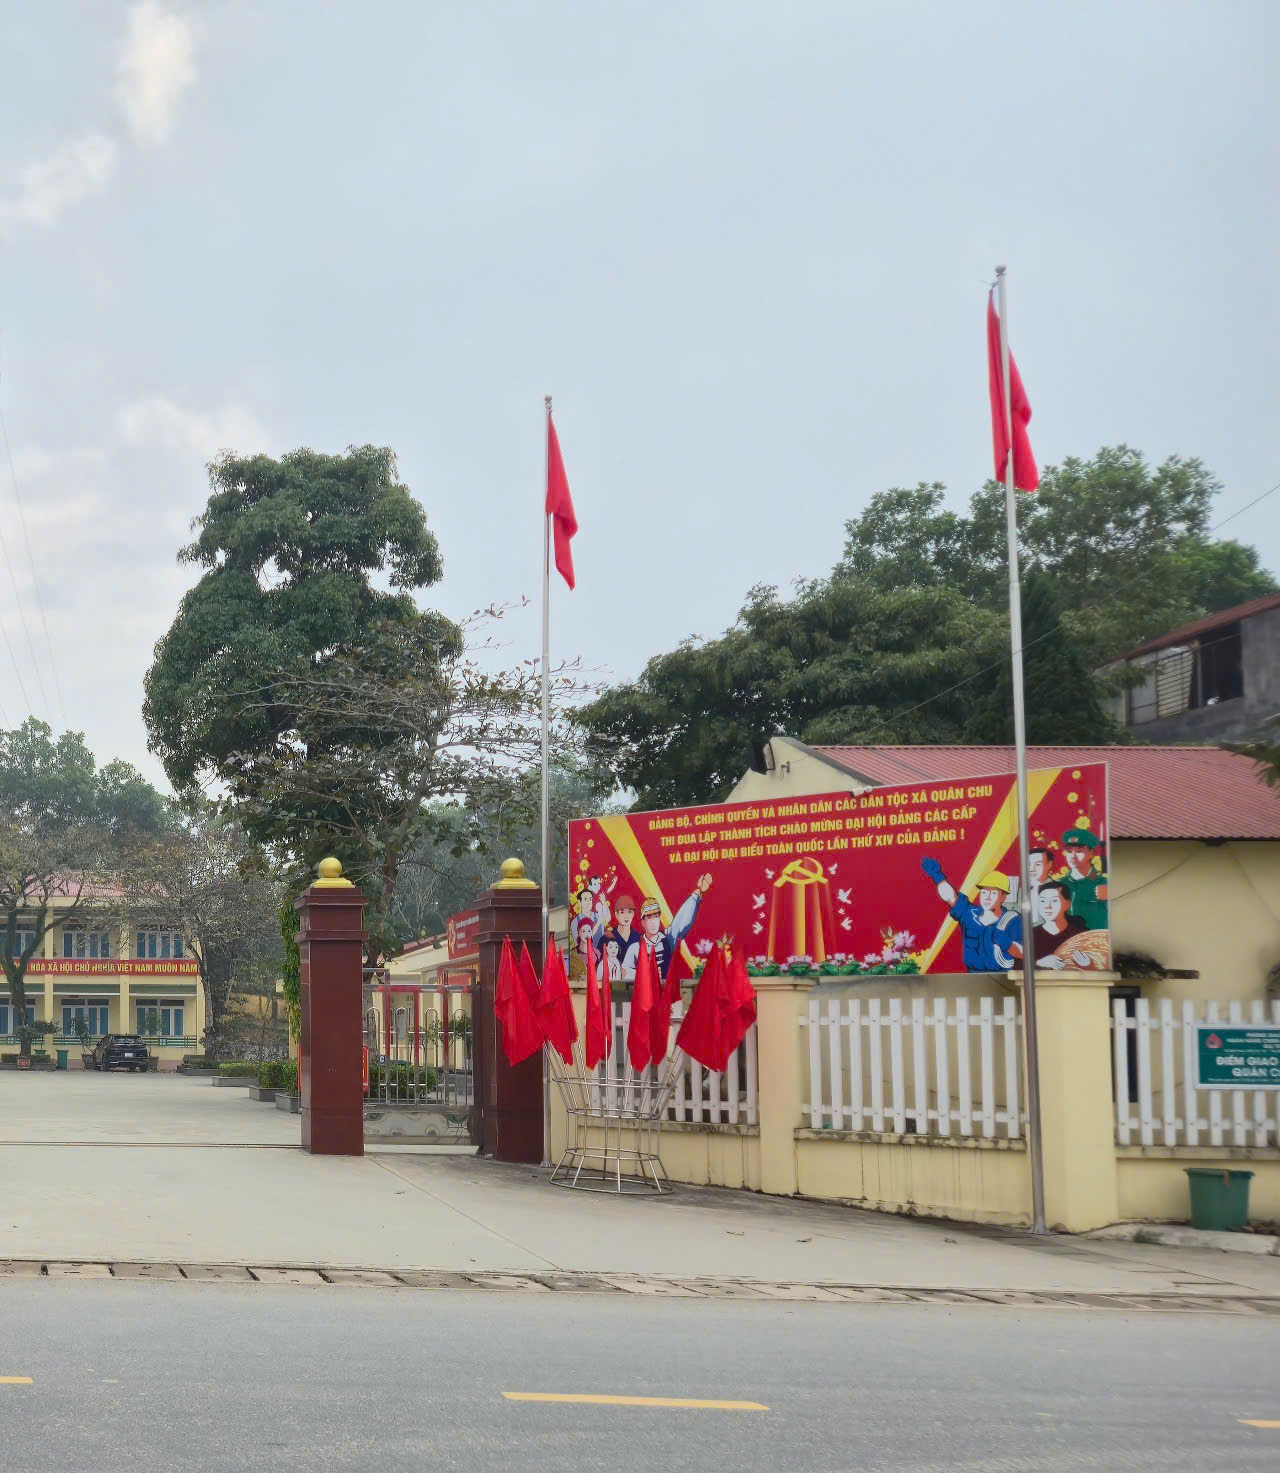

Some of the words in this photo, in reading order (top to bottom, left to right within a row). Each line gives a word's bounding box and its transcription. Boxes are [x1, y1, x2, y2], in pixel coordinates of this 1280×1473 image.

[649, 816, 674, 830] ĐẢNG
[695, 813, 724, 826] CHÍNH
[727, 807, 759, 823] QUYỀN
[762, 807, 775, 818] VÀ
[778, 803, 807, 817] NHÂN
[811, 800, 833, 814] DÂN
[835, 797, 857, 811] CÁC
[861, 795, 883, 809] DÂN
[886, 792, 908, 807] TỘC
[912, 790, 928, 804] XÃ
[931, 787, 964, 803] QUÂN
[967, 785, 993, 798] CHU
[660, 835, 675, 846] THI
[677, 833, 696, 845] ĐUA
[698, 830, 717, 845] LẬP
[719, 827, 752, 841] THÀNH
[755, 823, 776, 838] TÍCH
[780, 821, 808, 835] CHÀO
[811, 818, 843, 833] MỪNG
[846, 817, 864, 831] ĐẠI
[867, 814, 886, 829] HỘI
[889, 810, 922, 826] ĐẢNG
[924, 807, 948, 822] CÁC
[952, 803, 976, 820] CẤP
[669, 851, 681, 864] VÀ
[684, 851, 700, 864] ĐẠI
[702, 848, 719, 862] HỘI
[721, 847, 738, 861] ĐẠI
[740, 842, 764, 857] BIỂU
[766, 840, 793, 855] TOÀN
[796, 837, 824, 854] QUỐC
[827, 835, 848, 850] LẦN
[850, 833, 873, 848] THỨ
[875, 834, 893, 846] XIV
[897, 828, 920, 845] CỦA
[923, 826, 956, 843] ĐẢNG
[48, 961, 58, 972] XÃ
[60, 962, 72, 973] HỘI
[117, 962, 132, 973] VIỆT
[135, 963, 152, 972] NAM
[155, 962, 177, 972] MUÔN
